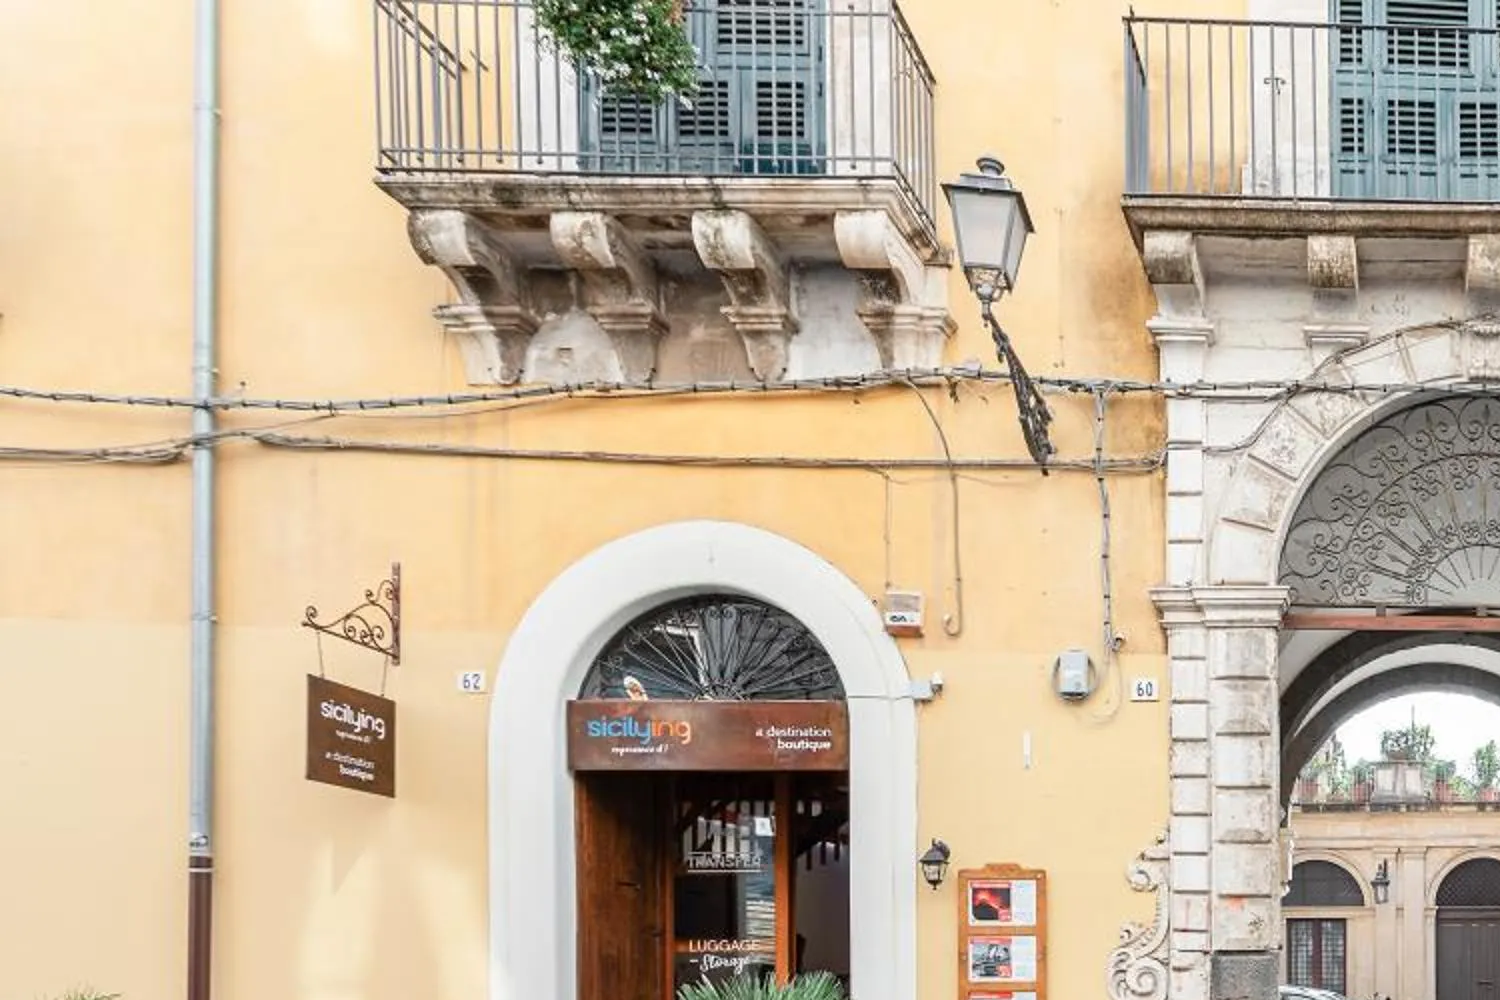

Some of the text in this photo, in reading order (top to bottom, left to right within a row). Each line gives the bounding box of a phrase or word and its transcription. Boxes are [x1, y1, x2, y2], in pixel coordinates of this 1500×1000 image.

[462, 672, 481, 691] 62
[1136, 681, 1153, 697] 60
[320, 699, 386, 740] sicilying
[587, 715, 691, 745] sicilying
[766, 725, 832, 737] destination
[777, 738, 831, 752] boutique
[688, 853, 762, 869] TRANSFER
[689, 939, 761, 952] LUGGAGE
